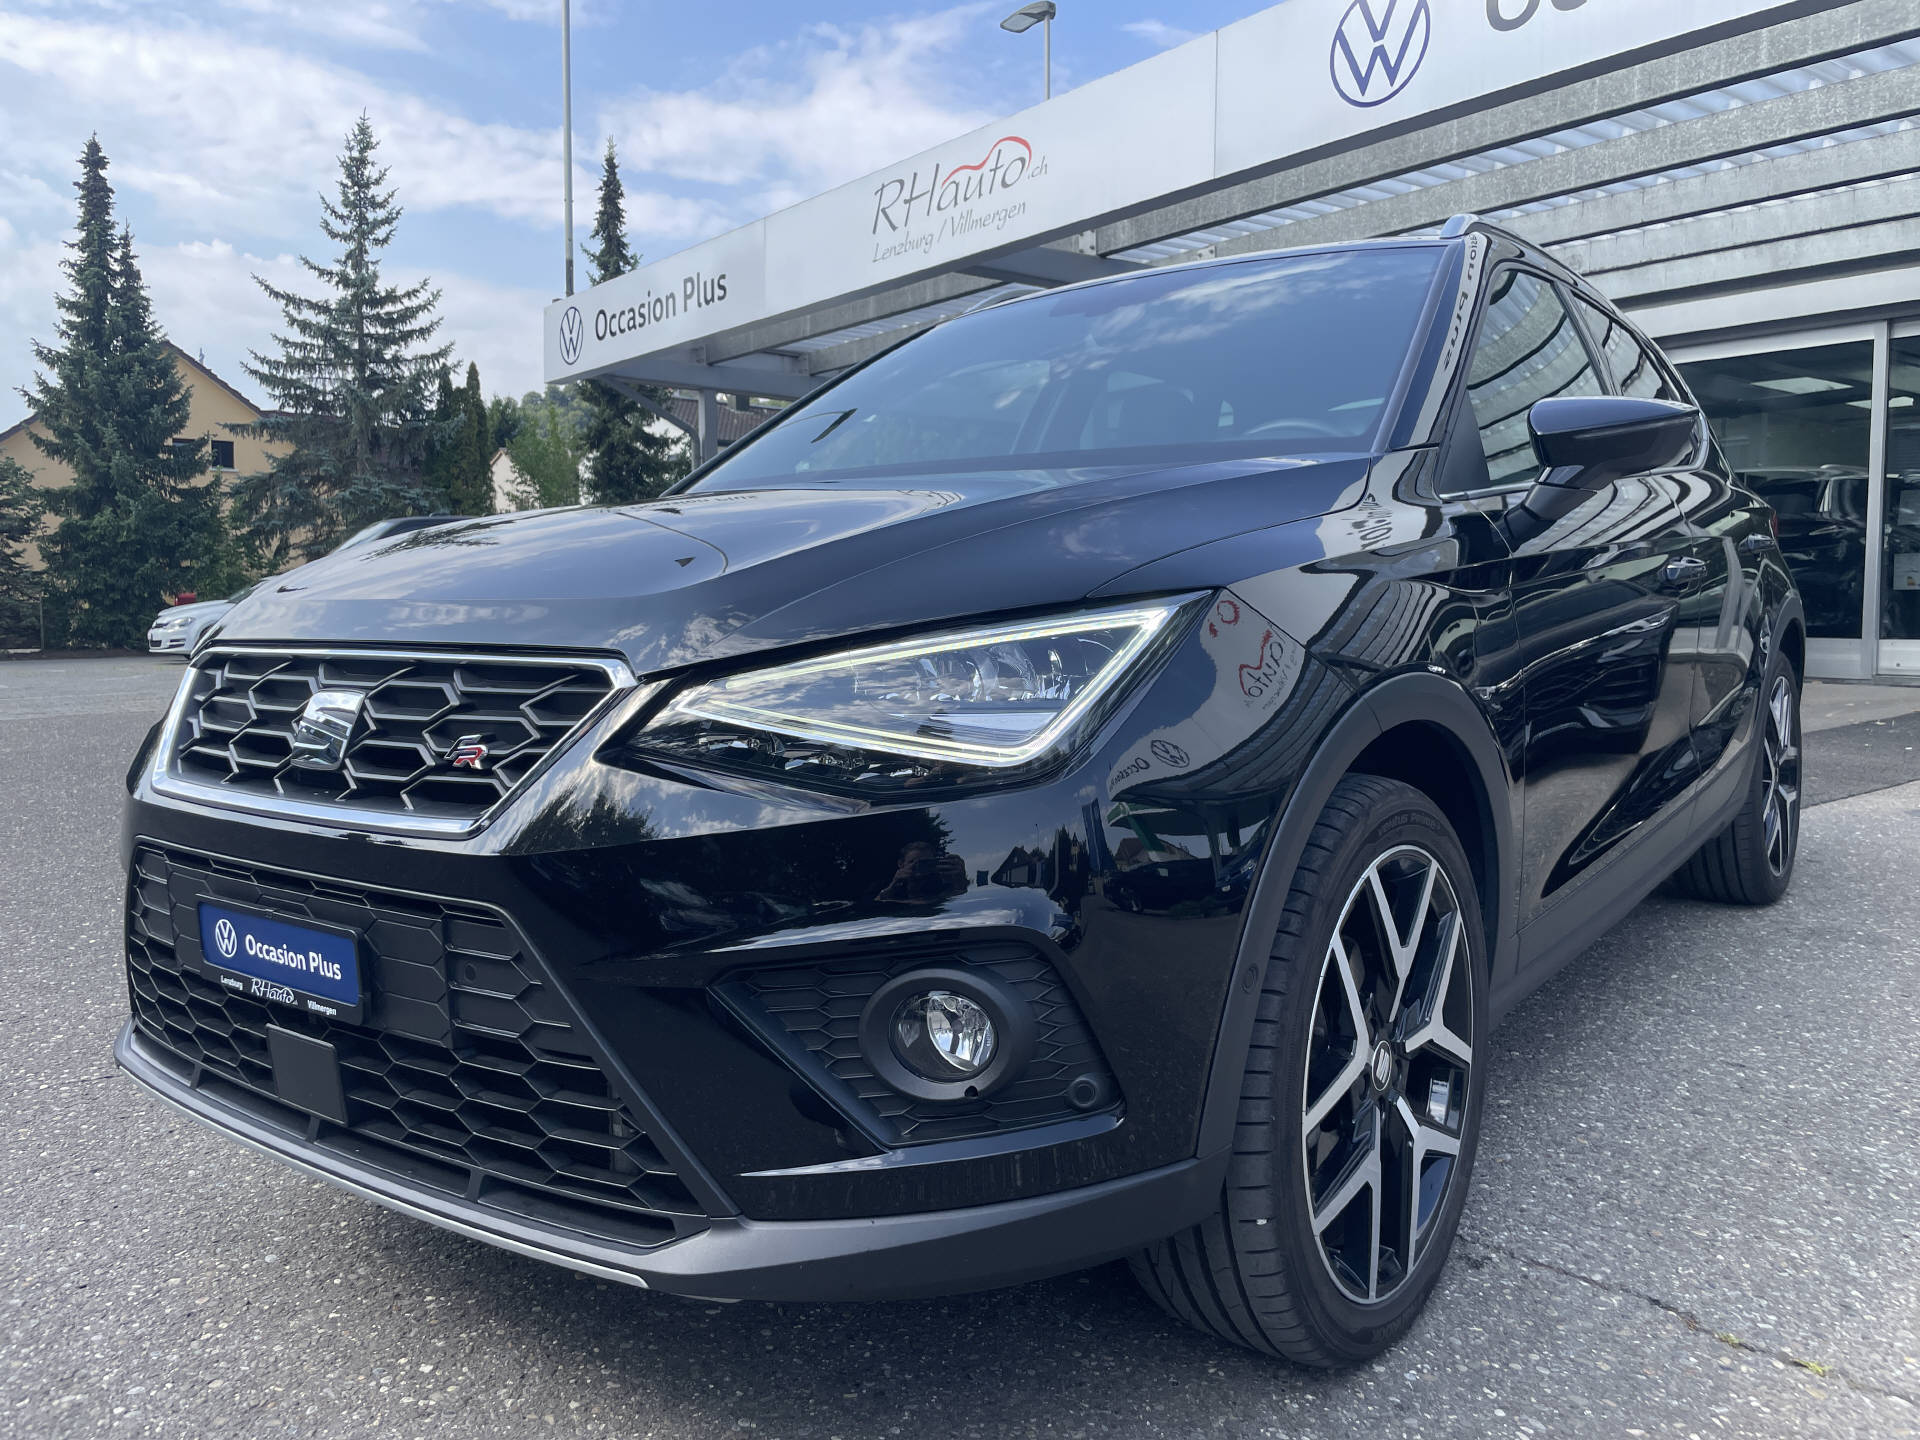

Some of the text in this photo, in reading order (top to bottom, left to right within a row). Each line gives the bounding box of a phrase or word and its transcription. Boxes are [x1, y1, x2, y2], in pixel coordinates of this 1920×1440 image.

[872, 231, 934, 263] Lenzburg
[951, 202, 1026, 237] Villmergen
[595, 290, 676, 341] Occasion
[683, 272, 727, 313] Plus
[245, 934, 307, 971] Occasion
[308, 951, 342, 980] Plus
